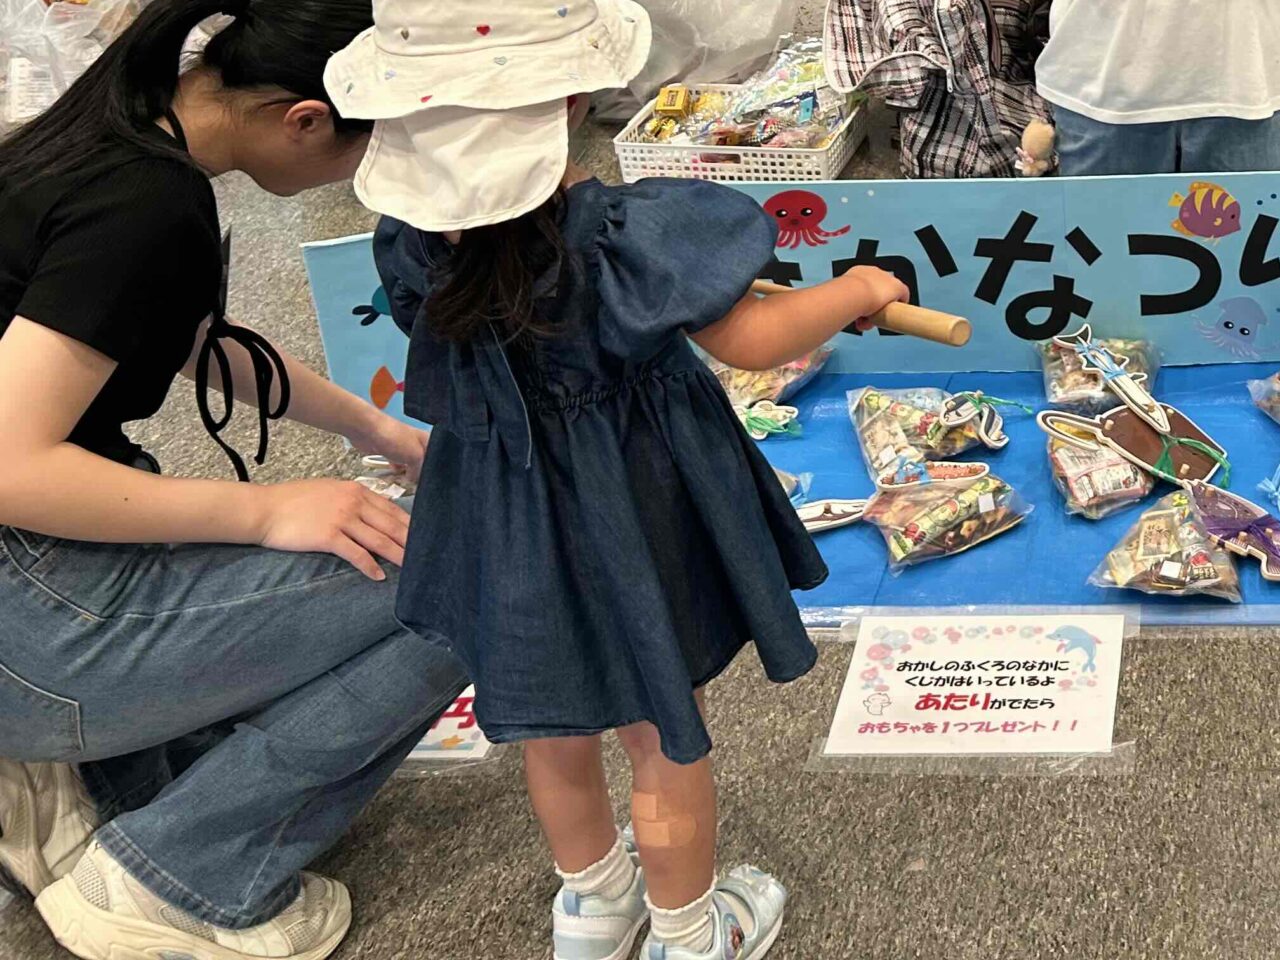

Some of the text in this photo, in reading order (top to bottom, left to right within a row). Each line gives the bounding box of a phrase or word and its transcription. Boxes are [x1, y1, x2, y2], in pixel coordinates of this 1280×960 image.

[896, 660, 1070, 672] おかしのふくろのなかに
[905, 675, 1056, 687] くじがはいっているよ
